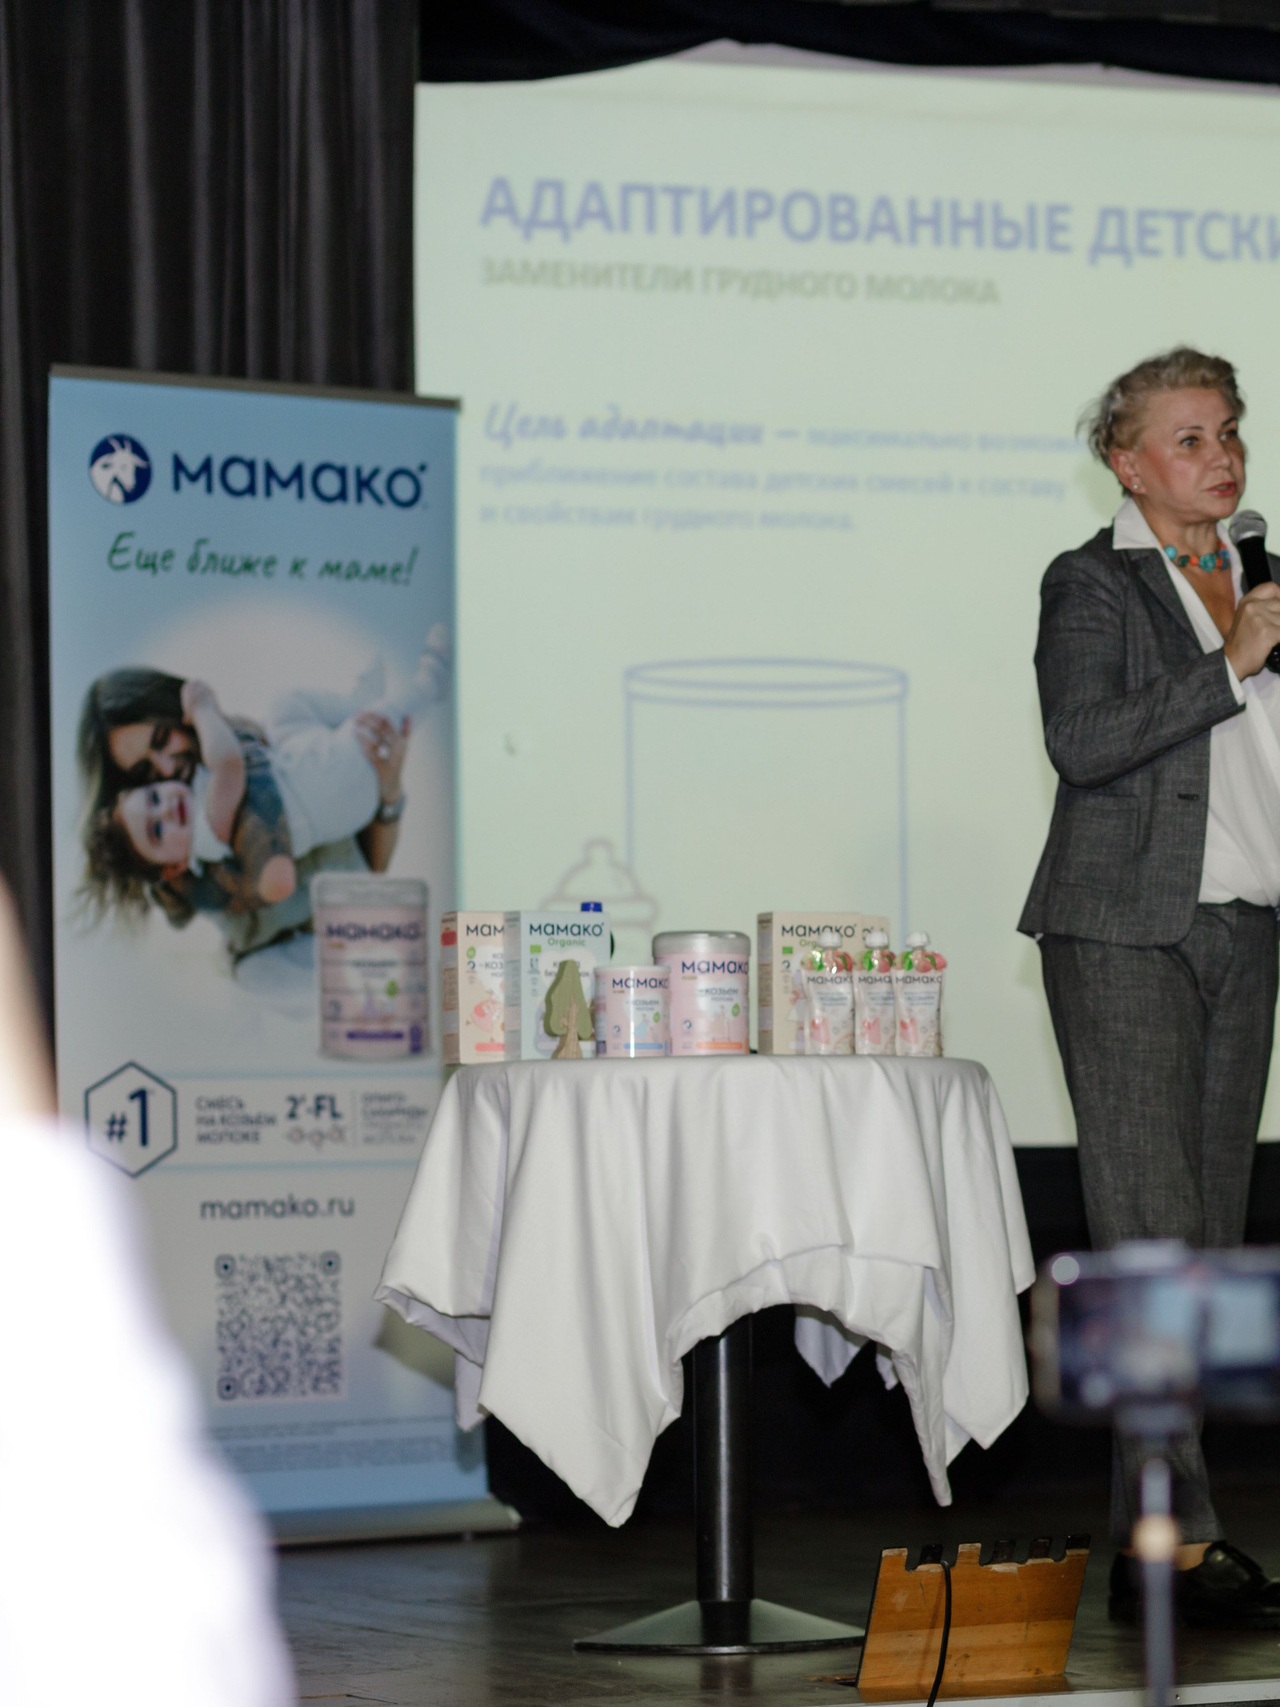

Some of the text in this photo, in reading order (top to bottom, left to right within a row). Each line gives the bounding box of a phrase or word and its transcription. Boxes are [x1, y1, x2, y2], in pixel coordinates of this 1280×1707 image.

[480, 176, 1072, 253] АДАПТИРОВАННЫЕ
[481, 259, 1000, 304] ЗАМЕНИТЕЛИ ГРУДНОГО МОЛОКА
[484, 401, 568, 448] Цель
[579, 405, 765, 449] адаптации
[107, 532, 419, 586] Еще ближе к маме!
[547, 938, 587, 948] Organic
[105, 1088, 152, 1148] #1
[200, 1193, 355, 1220] mamako.ru
